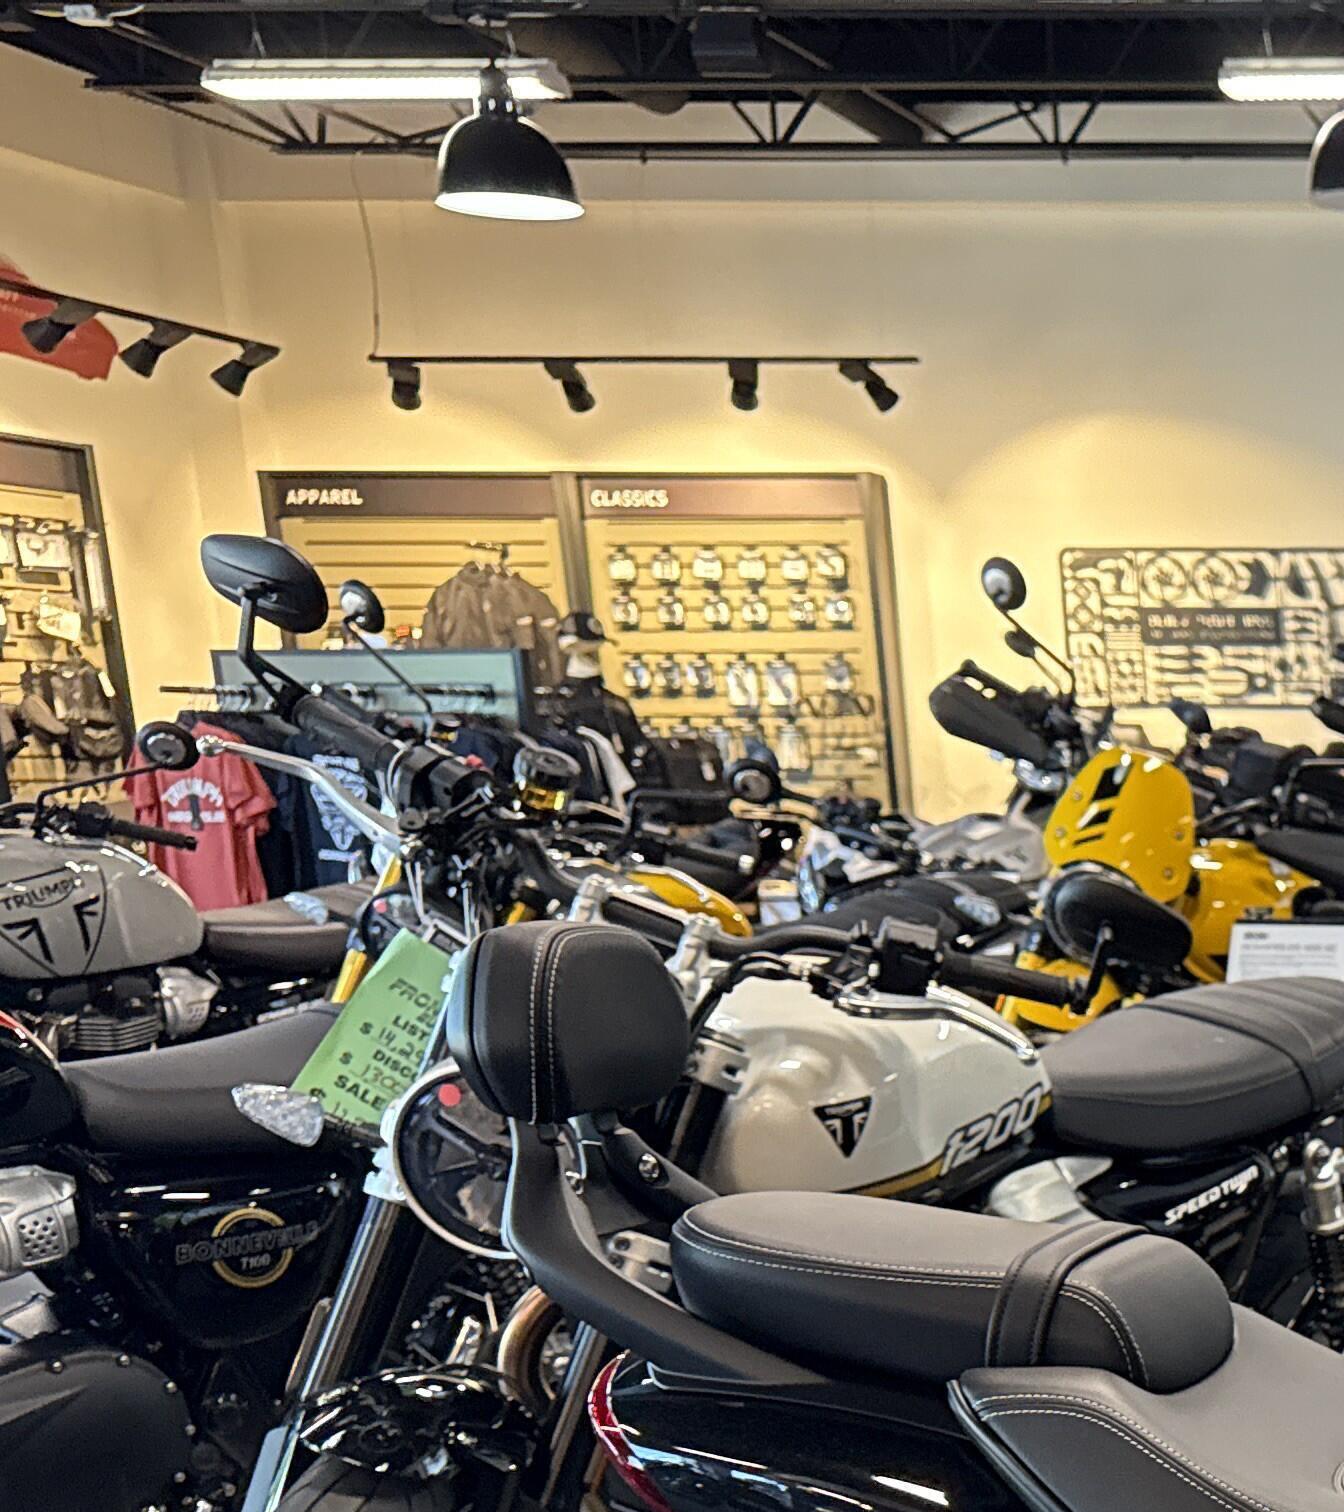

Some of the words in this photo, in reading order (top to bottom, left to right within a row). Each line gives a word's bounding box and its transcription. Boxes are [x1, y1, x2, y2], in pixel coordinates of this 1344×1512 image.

[286, 488, 363, 506] APPAREL
[590, 489, 669, 508] CLASSICS
[3, 875, 86, 911] TRIUMPH
[333, 1074, 386, 1111] SALE
[939, 1086, 1045, 1177] 1200
